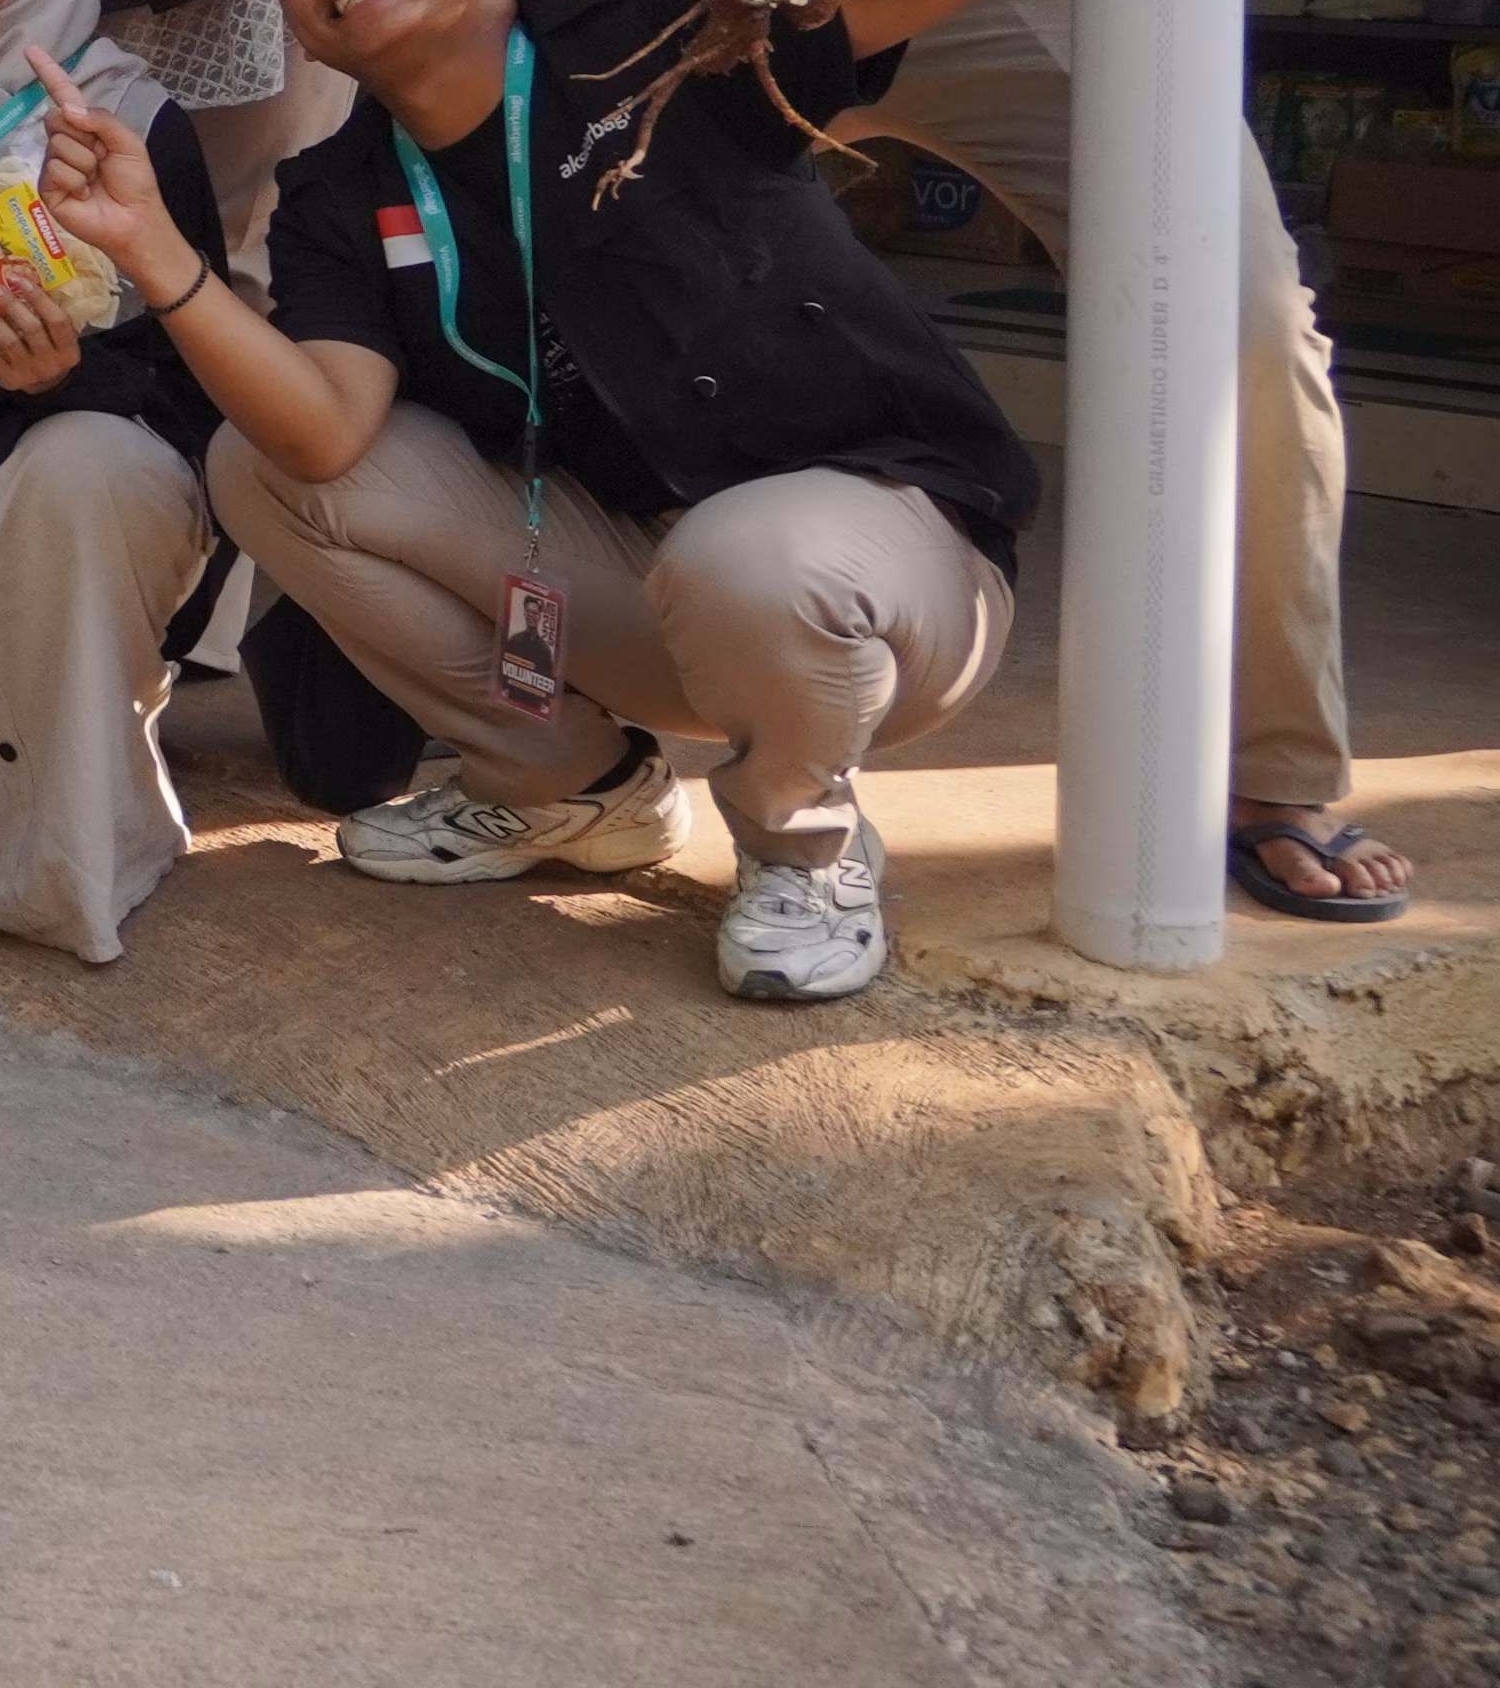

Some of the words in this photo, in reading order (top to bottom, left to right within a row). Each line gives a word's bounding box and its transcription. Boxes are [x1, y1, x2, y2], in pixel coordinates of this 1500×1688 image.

[31, 206, 61, 256] KAROMAH
[1151, 278, 1168, 292] D
[1150, 302, 1169, 360] SUPER
[502, 660, 556, 694] VOLUNTEER
